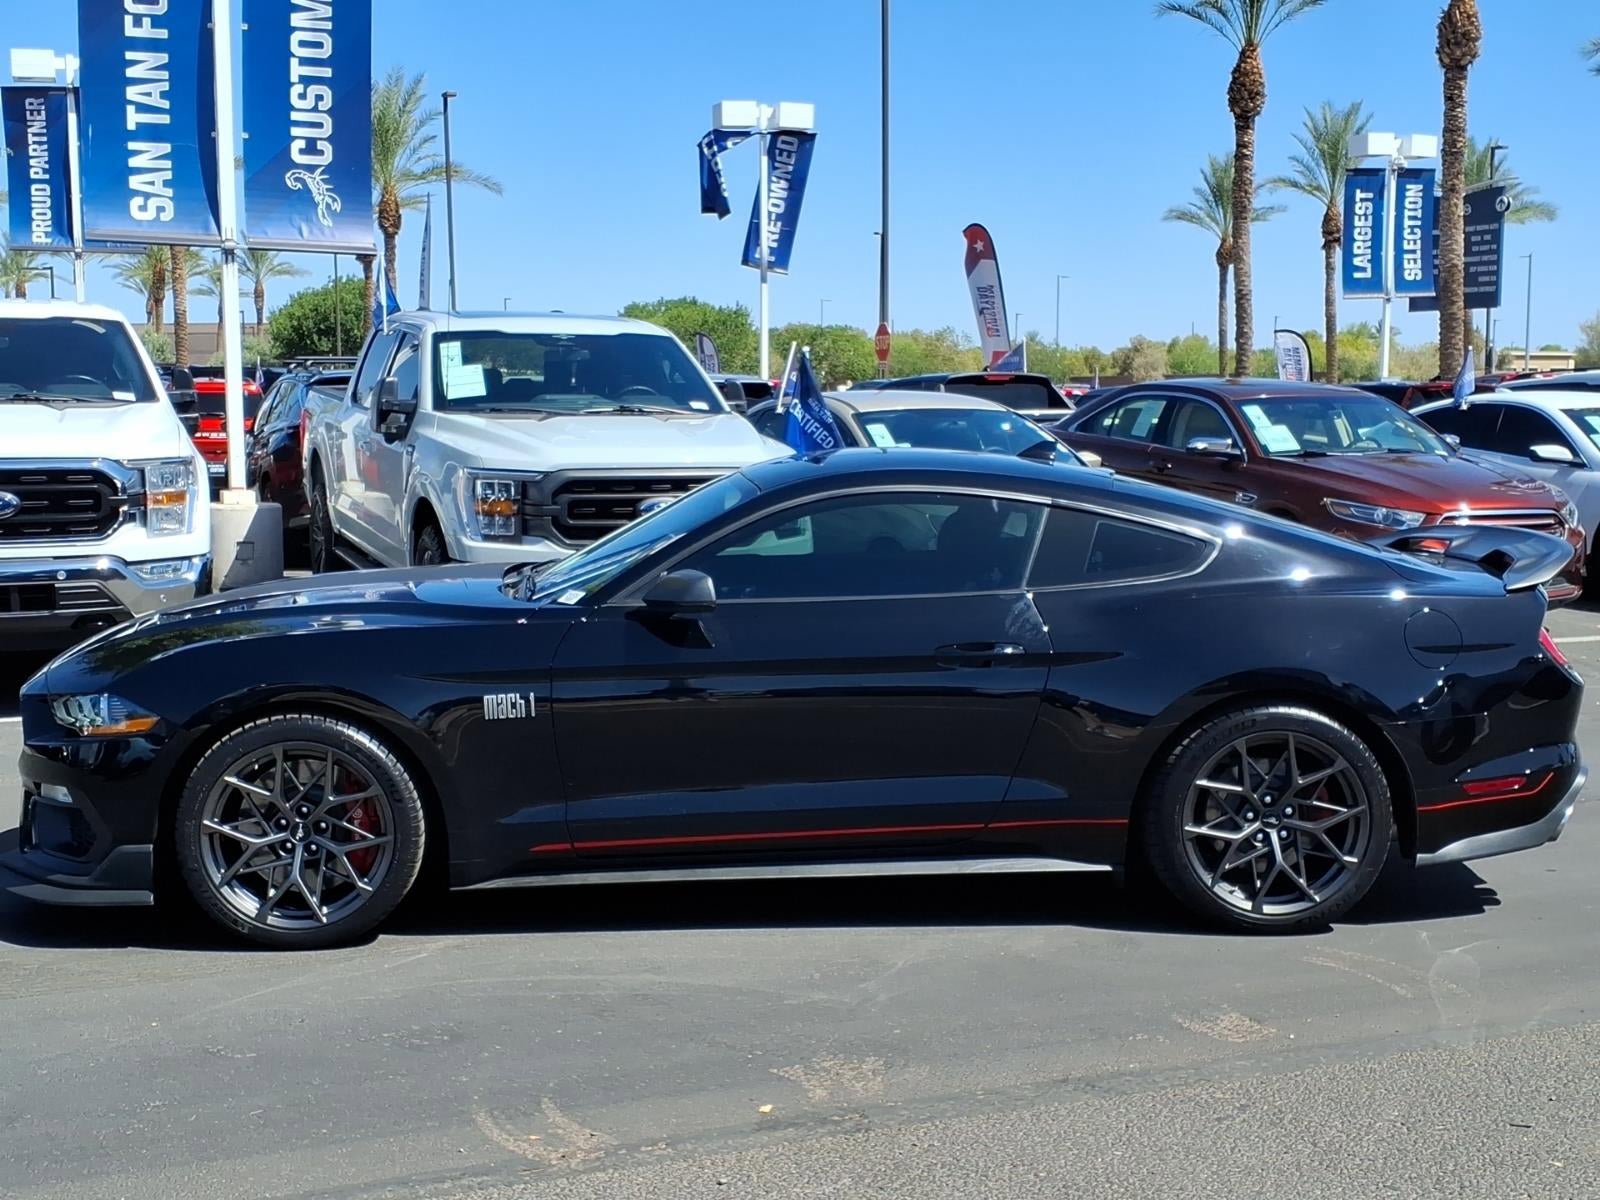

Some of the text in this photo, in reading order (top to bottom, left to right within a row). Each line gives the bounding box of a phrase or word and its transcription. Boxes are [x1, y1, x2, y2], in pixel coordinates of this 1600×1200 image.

[124, 51, 171, 131] TAN
[25, 97, 52, 244] PROUD PARTNER
[129, 141, 174, 221] SAN
[1352, 189, 1374, 279] LARGEST
[1404, 184, 1423, 281] SELECTION
[529, 691, 536, 717] 1
